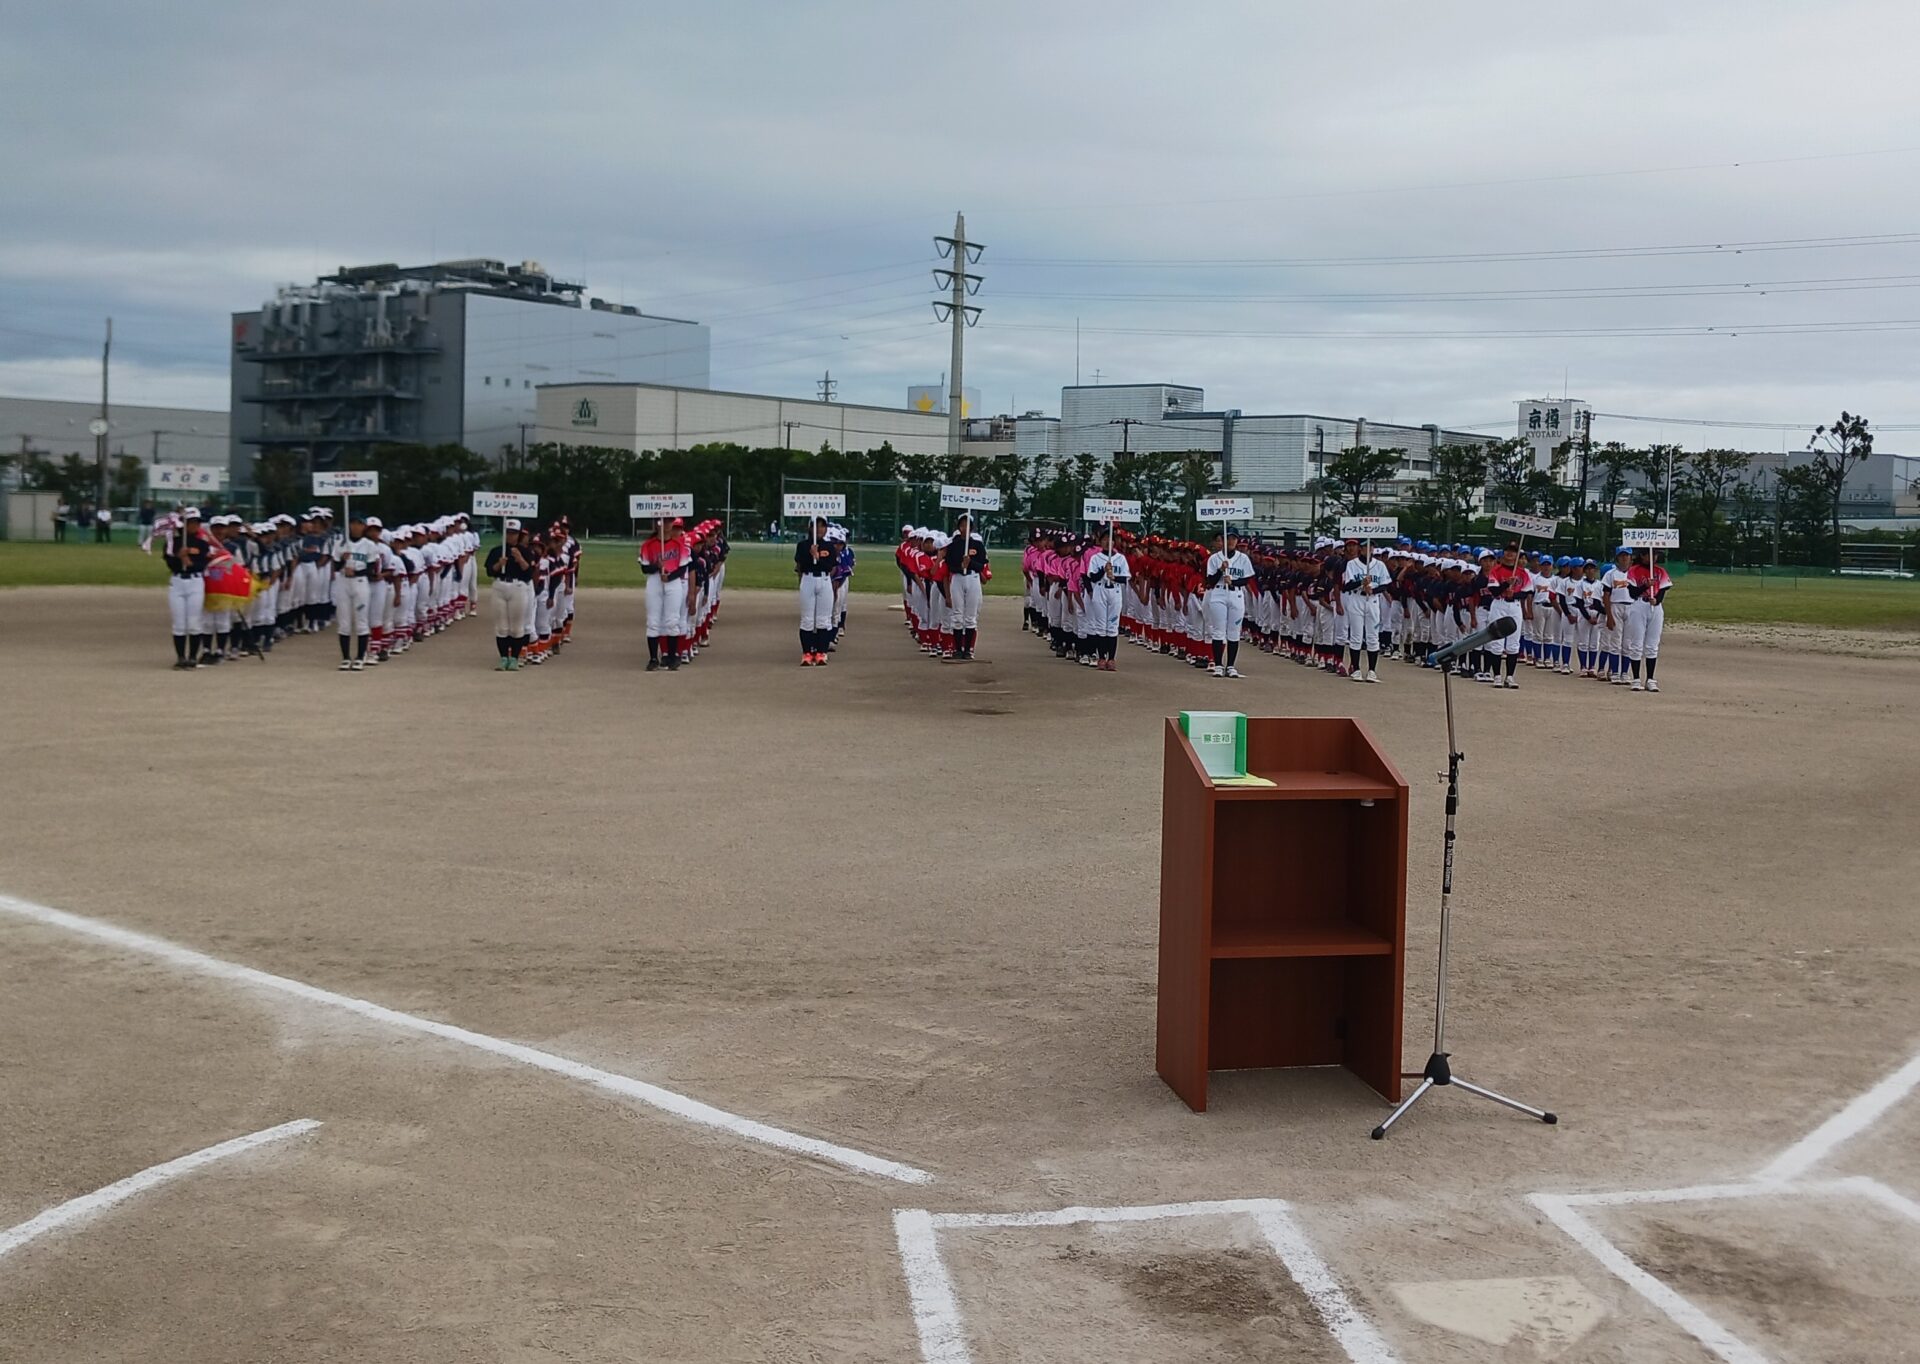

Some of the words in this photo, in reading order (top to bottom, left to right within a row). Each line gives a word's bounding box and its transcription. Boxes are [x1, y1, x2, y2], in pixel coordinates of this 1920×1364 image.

[1528, 408, 1560, 430] 京樽
[942, 494, 998, 505] なでしこチャーミング
[636, 502, 687, 510] 市川ガールズ
[1085, 505, 1139, 515] 千葉ドリームガールズ
[1624, 530, 1678, 540] やまゆりガールズ
